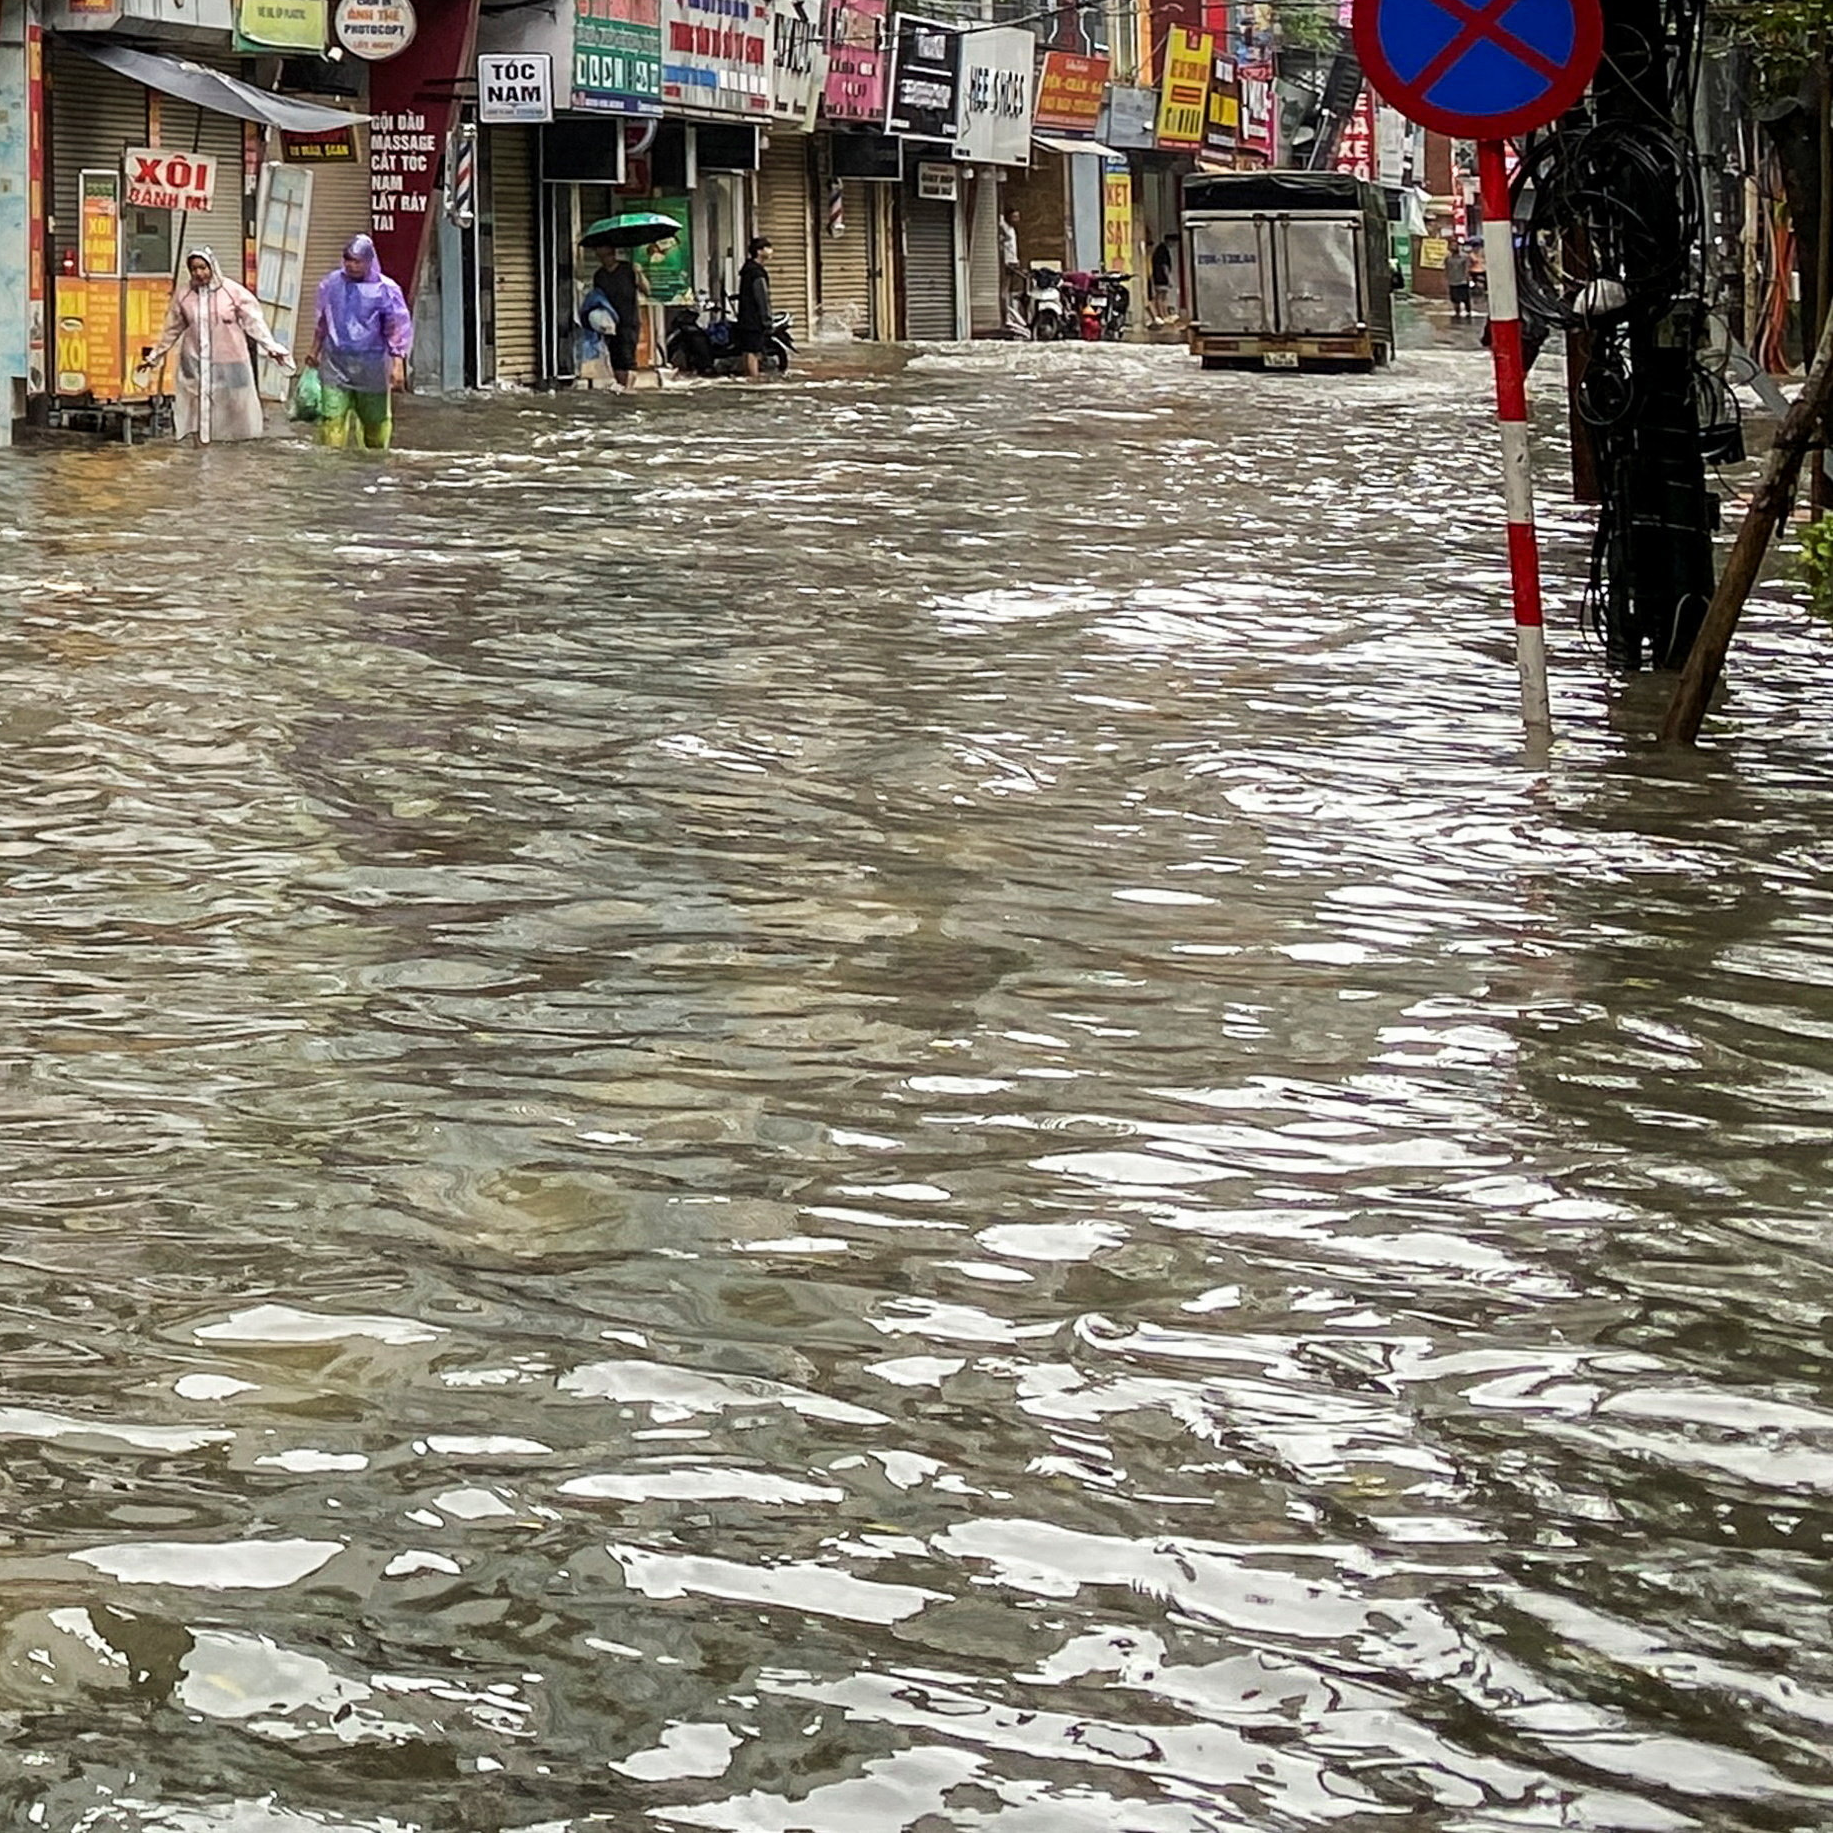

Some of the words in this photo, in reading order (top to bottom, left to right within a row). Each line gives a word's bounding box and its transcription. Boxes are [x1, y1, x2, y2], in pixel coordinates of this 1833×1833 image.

[491, 58, 535, 81] TÓC
[487, 86, 541, 102] NAM
[371, 134, 436, 152] MASSAGE
[400, 151, 428, 172] TÓC
[135, 154, 208, 192] XÔI
[371, 175, 404, 191] NAM
[372, 215, 395, 231] TAI
